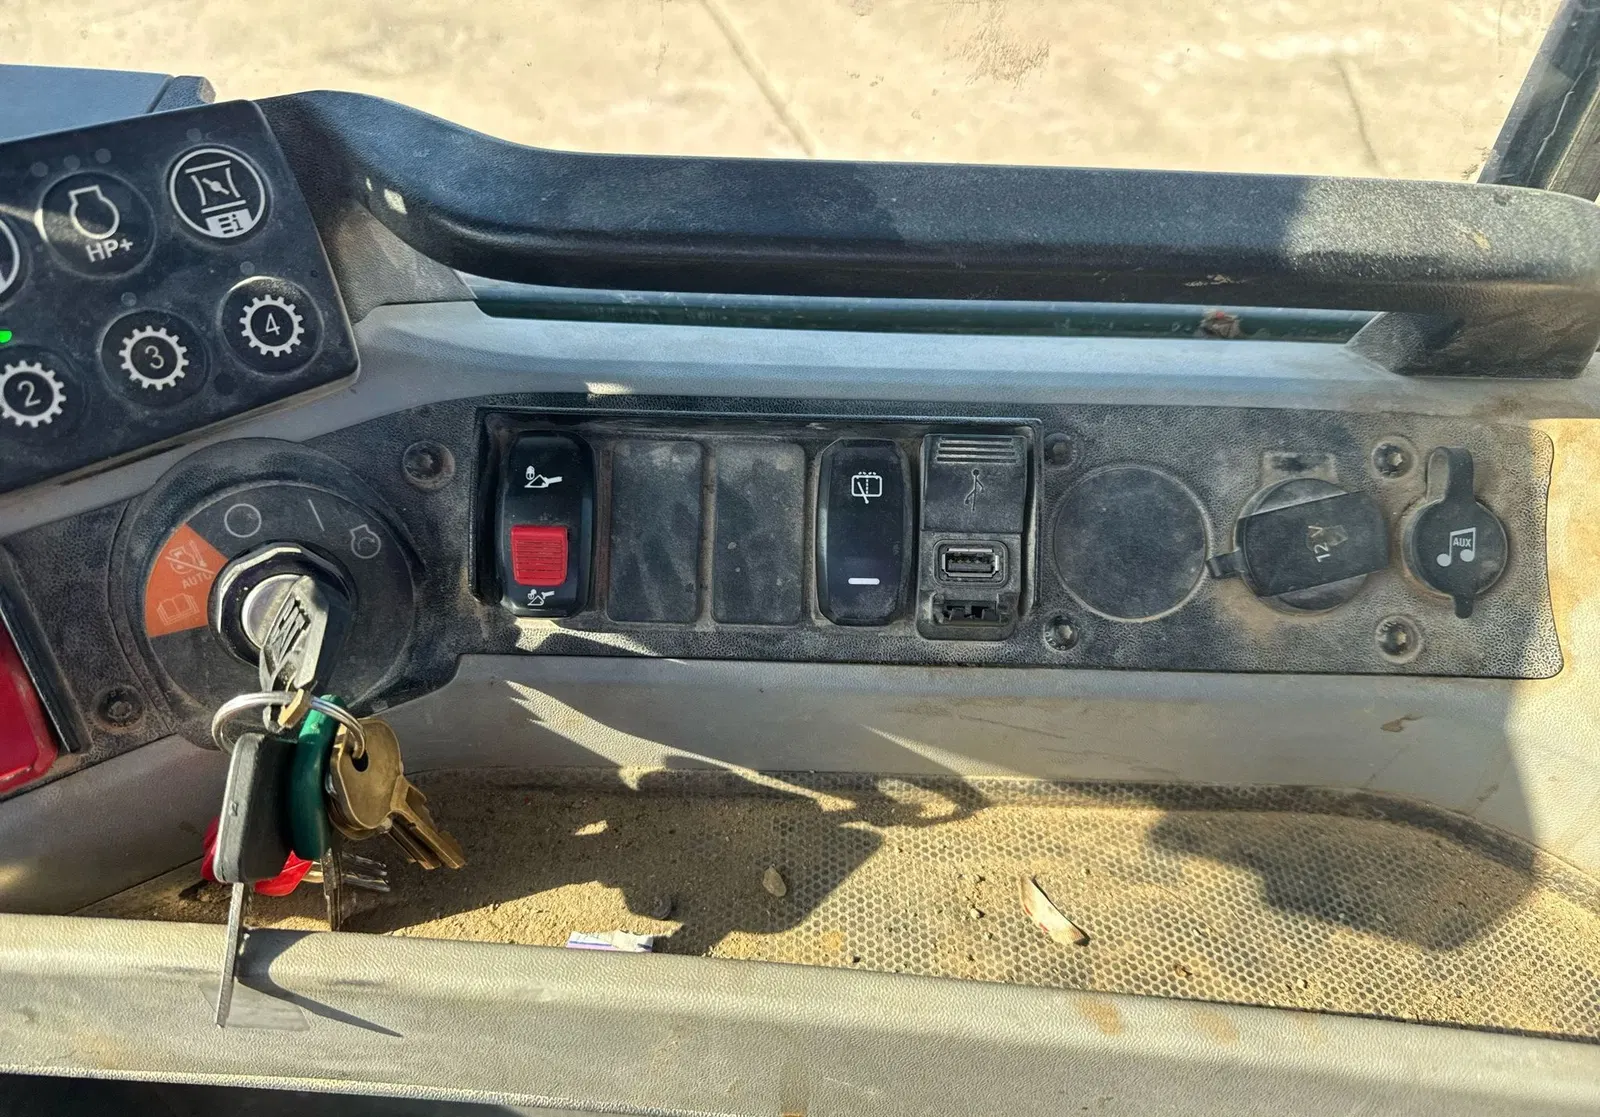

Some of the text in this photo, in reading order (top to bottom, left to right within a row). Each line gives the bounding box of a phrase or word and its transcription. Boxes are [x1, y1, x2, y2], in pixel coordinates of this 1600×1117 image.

[85, 238, 134, 263] HP+
[264, 312, 280, 336] 4
[144, 345, 165, 369] 3
[17, 380, 41, 407] 2
[1452, 537, 1472, 548] AUX
[182, 571, 212, 590] AUTO
